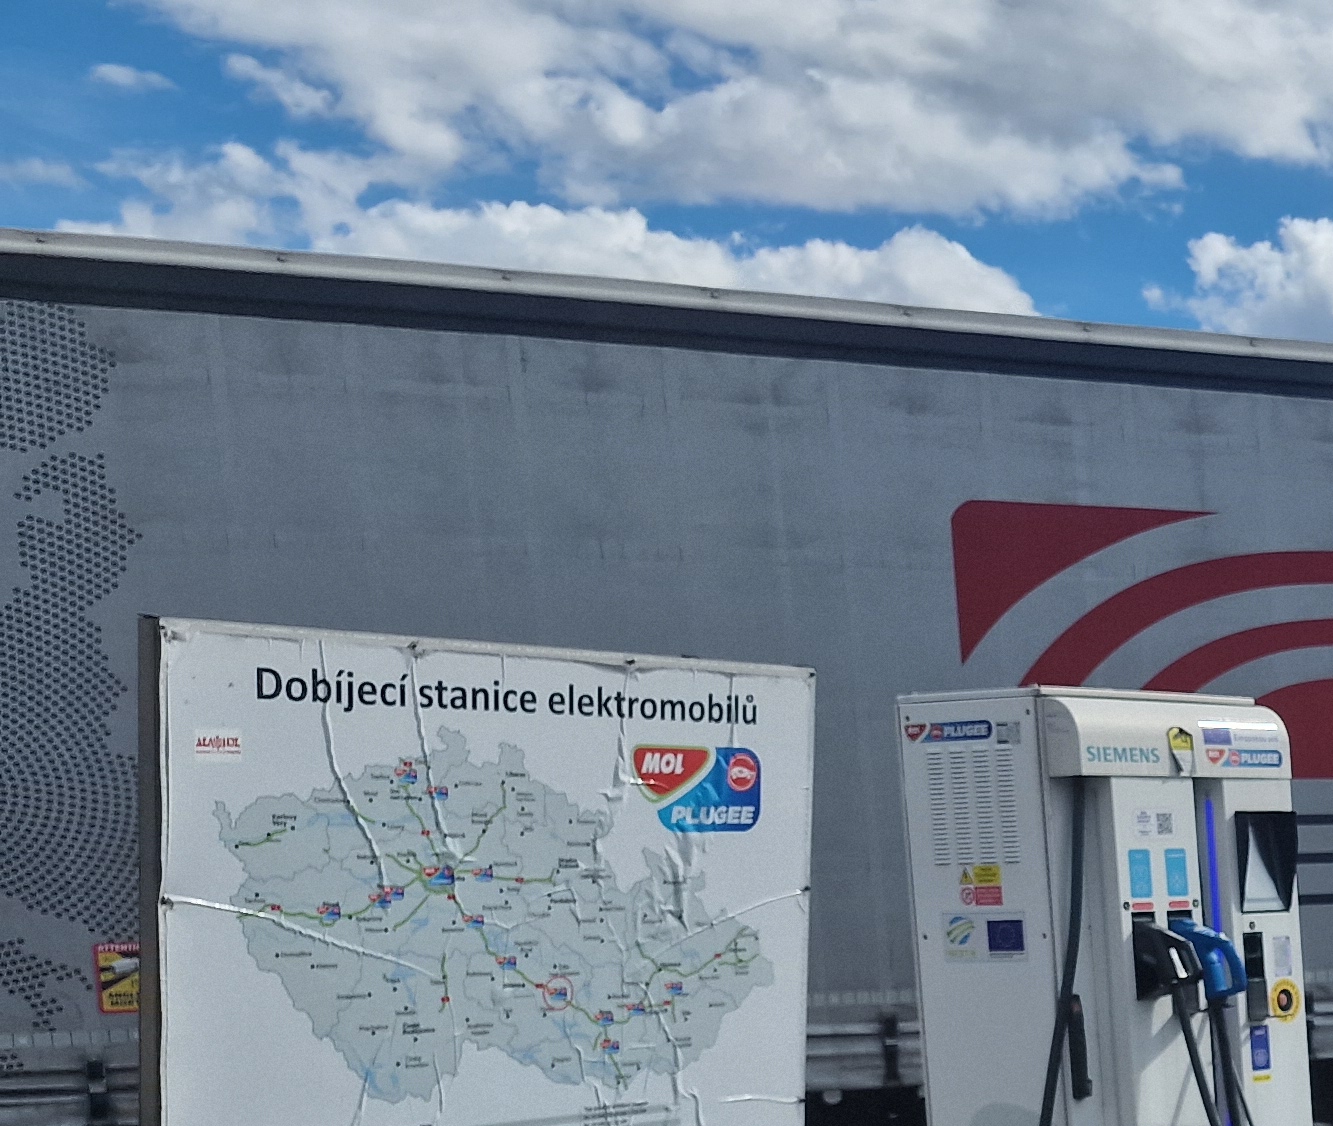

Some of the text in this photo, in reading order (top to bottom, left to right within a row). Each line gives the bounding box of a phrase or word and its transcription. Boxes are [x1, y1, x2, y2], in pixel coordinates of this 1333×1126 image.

[256, 666, 757, 725] Dobíjecí stanice elektromobilů
[944, 725, 989, 738] PLUGEE
[641, 752, 684, 775] MOL
[1086, 746, 1160, 763] SIEMENS
[1241, 753, 1280, 765] PLUGEE
[671, 806, 756, 825] PLUGEE
